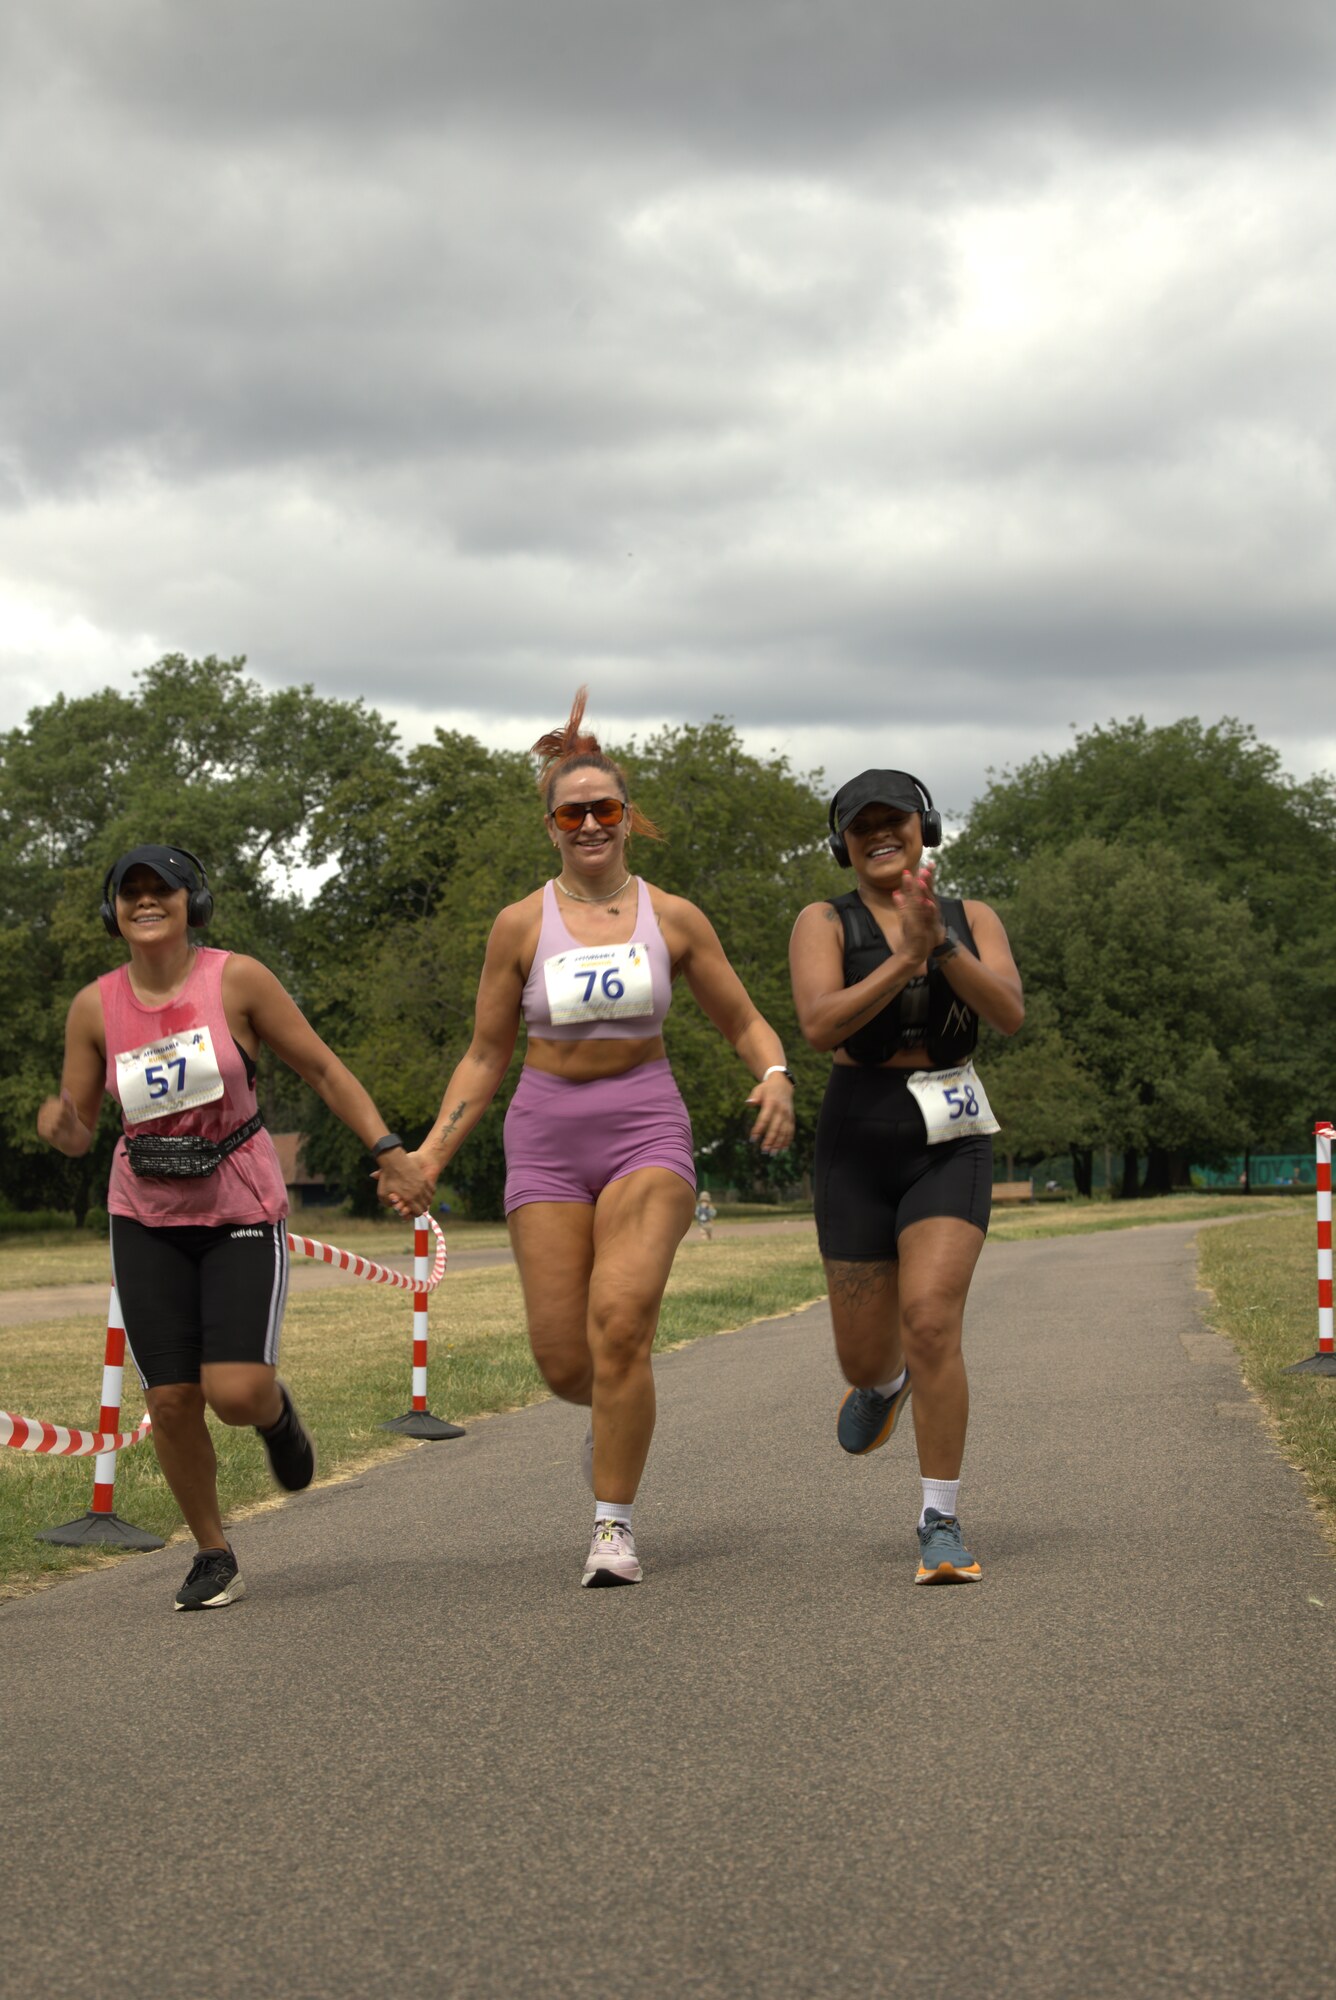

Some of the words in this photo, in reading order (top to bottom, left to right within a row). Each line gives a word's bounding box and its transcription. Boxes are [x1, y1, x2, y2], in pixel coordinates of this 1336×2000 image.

[574, 967, 625, 1002] 76
[145, 1057, 187, 1099] 57
[943, 1085, 979, 1119] 58
[230, 1228, 264, 1239] adidas
